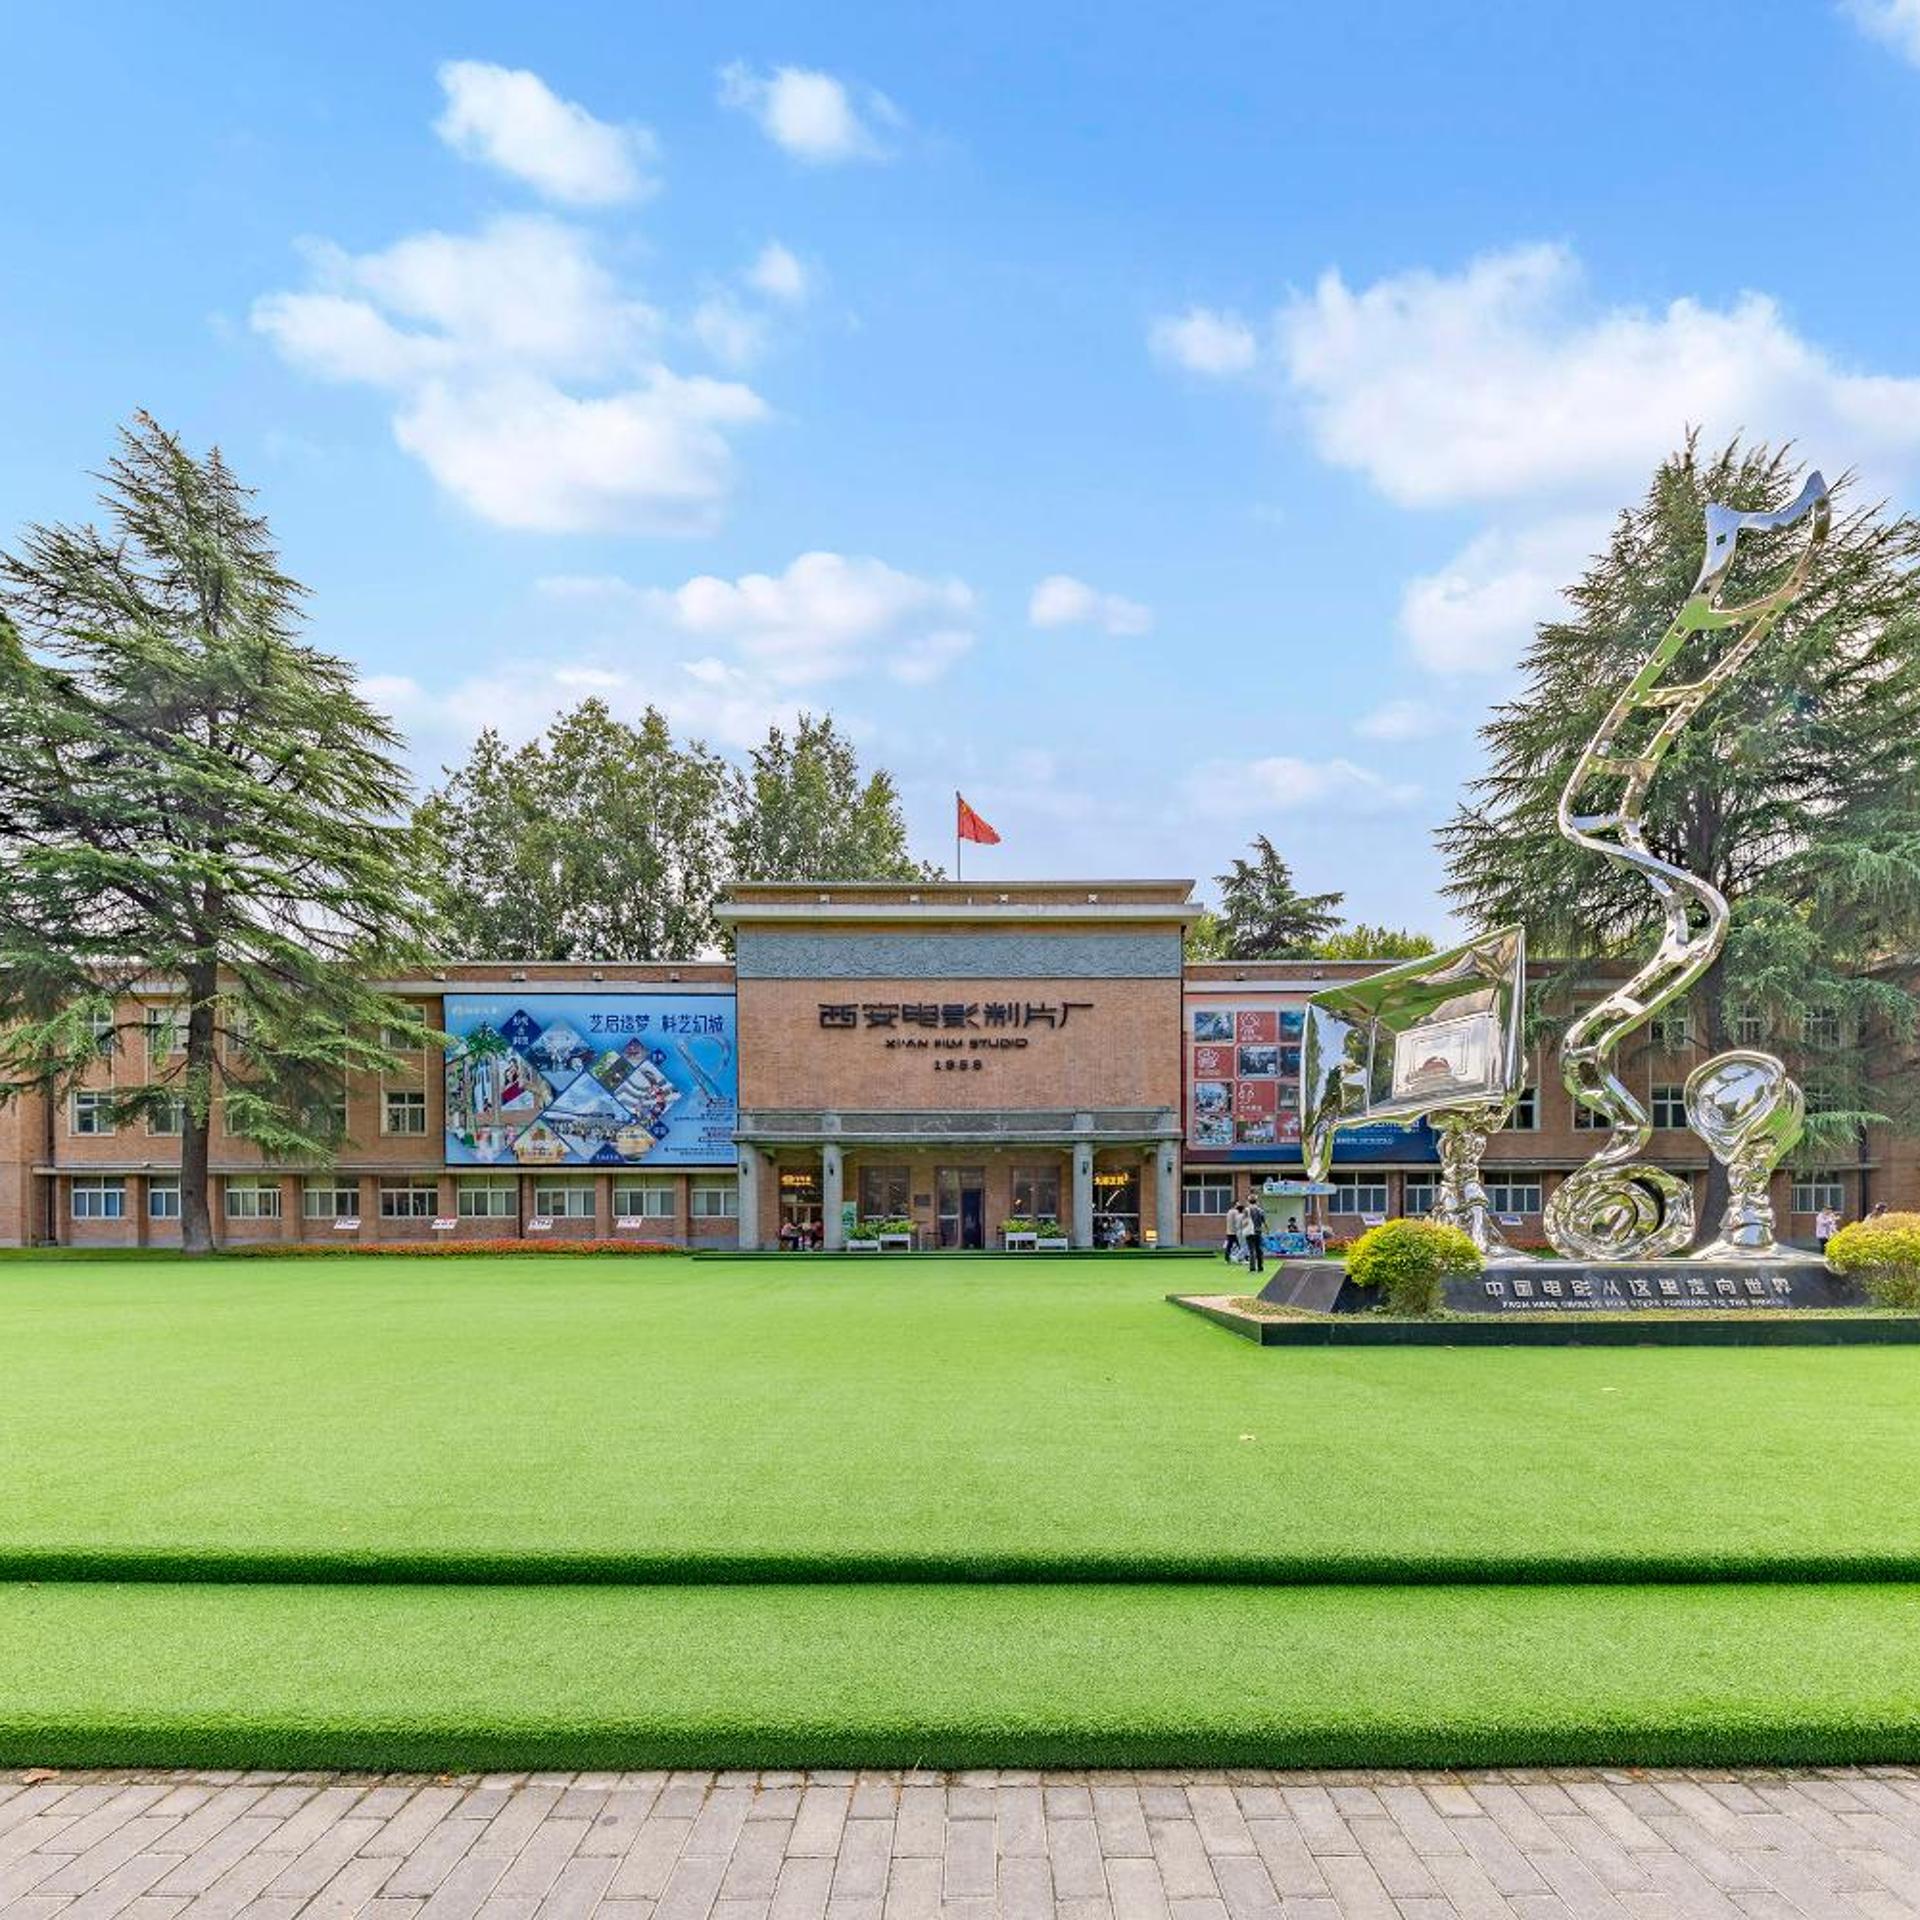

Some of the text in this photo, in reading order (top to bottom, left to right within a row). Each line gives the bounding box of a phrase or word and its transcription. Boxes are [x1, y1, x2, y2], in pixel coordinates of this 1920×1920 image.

[817, 1002, 1094, 1029] 西安电影制片厂
[885, 1038, 1029, 1049] XI'AN FILM STUDIO
[1485, 1278, 1793, 1297] 中国电影从这里走向世界
